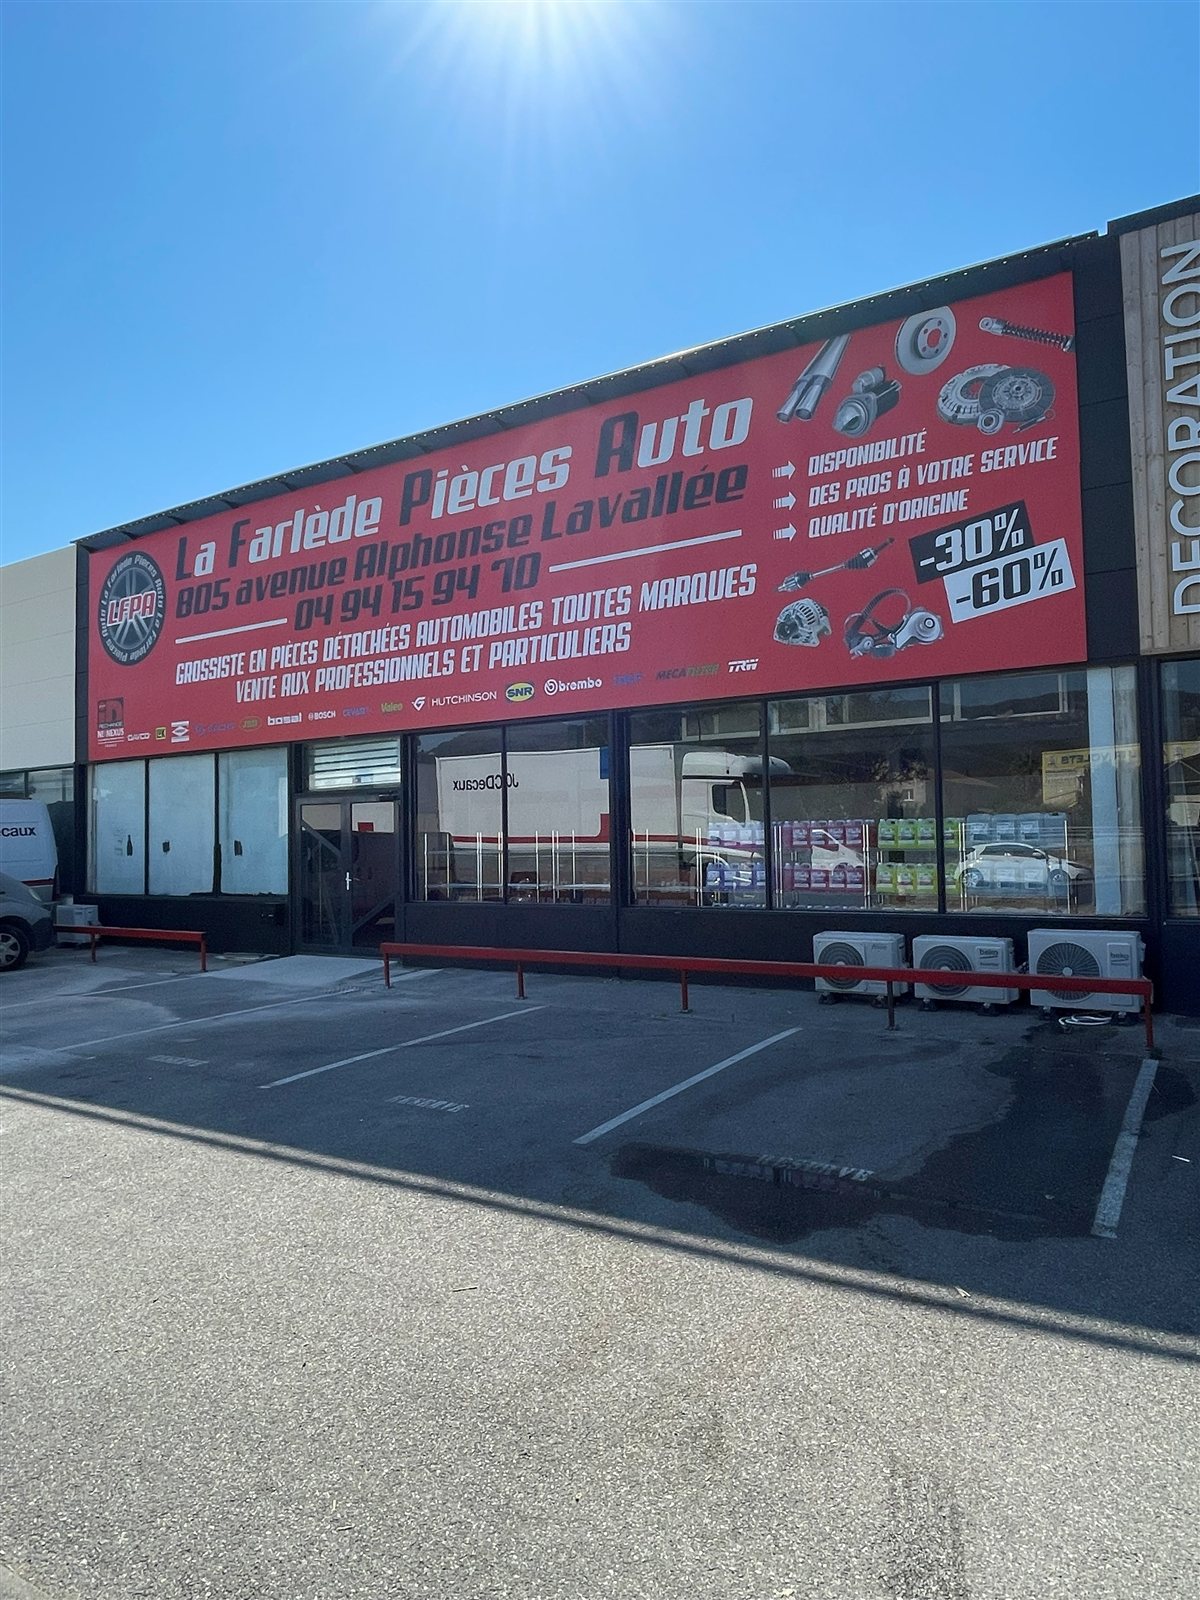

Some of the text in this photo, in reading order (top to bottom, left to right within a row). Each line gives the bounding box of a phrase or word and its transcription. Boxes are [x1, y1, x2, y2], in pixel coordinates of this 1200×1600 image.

[808, 428, 927, 477] DISPONIBILITÉ
[808, 437, 1059, 508] DES PROS À VOTRE SERVICE
[175, 397, 754, 580] La Farlède Pièces Auto
[808, 488, 970, 539] QUALITÉ D'ORIGINE
[175, 464, 749, 619] 805 avenue Alphonse Lavallée
[919, 508, 1026, 573] -30%
[294, 552, 542, 631] 04 94 15 94 70
[955, 548, 1065, 610] -60%
[106, 590, 157, 627] LFPA
[175, 563, 758, 685] GROSSISTE EN PIÈCES DÉTACHÉES AUTOMOBILES TOUTES MARQUES
[235, 621, 632, 703] VENTE AUX PROFESSIONNELS ET PARTICULIERS
[558, 678, 603, 692] brembo
[728, 658, 759, 673] TRW
[314, 710, 336, 720] BOSCH
[431, 691, 497, 707] HUTCHINSON
[507, 686, 533, 698] SNR
[267, 712, 302, 726] bosal
[0, 826, 37, 837] caux
